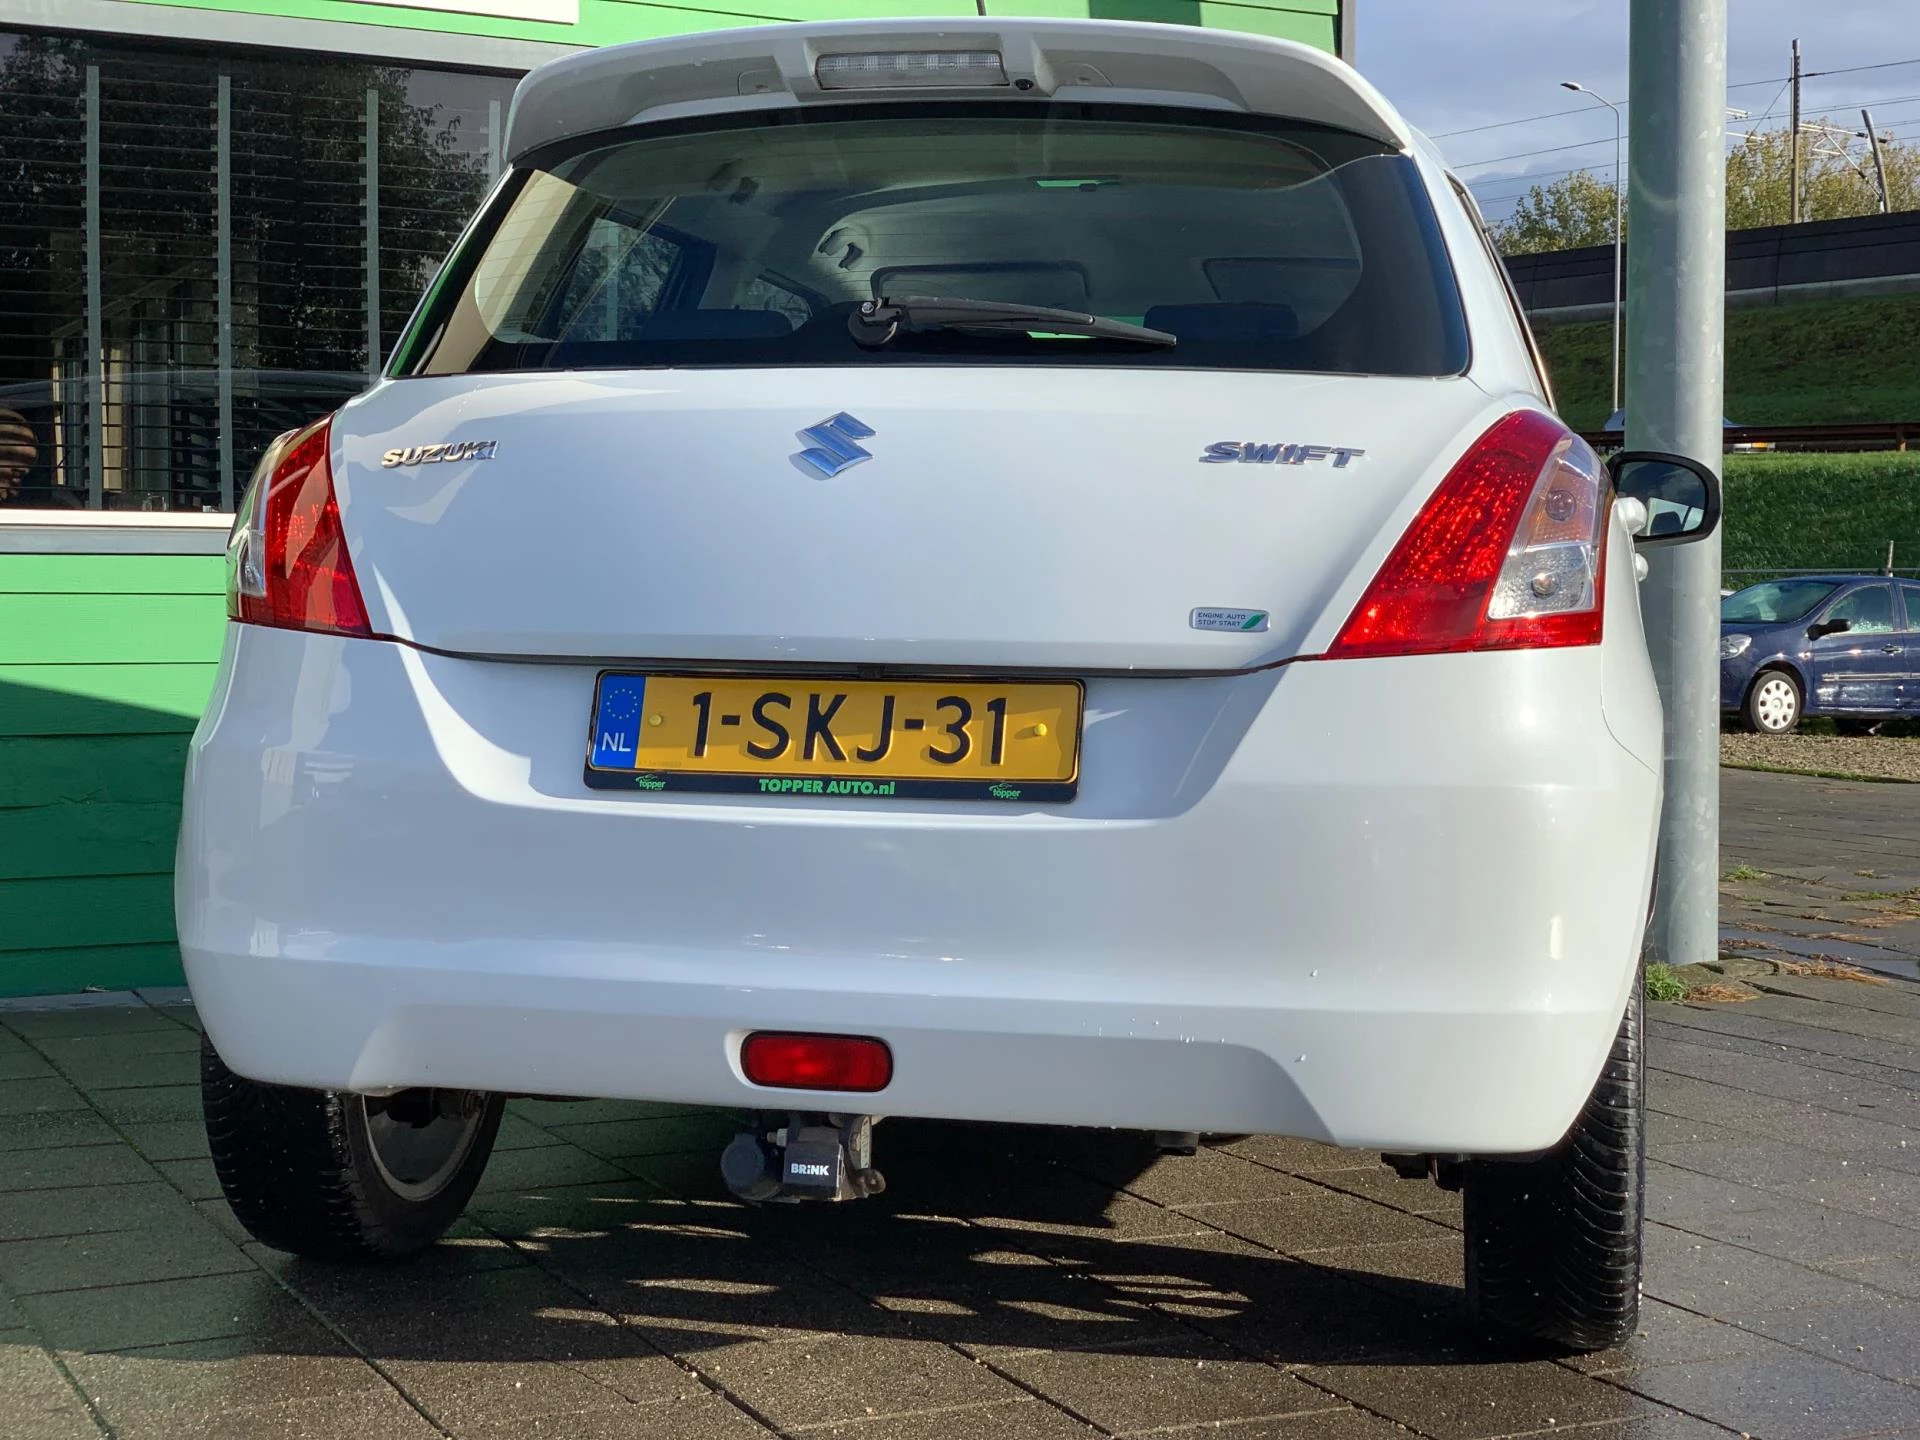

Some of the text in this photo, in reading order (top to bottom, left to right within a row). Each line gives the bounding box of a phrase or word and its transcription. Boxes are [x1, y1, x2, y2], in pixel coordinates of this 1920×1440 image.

[381, 440, 499, 469] SUZUKI
[1198, 441, 1365, 468] SWIFT
[601, 732, 631, 752] NL
[692, 691, 1007, 766] 1-SKJ-31
[759, 779, 896, 795] TOPPER AUTO.nl
